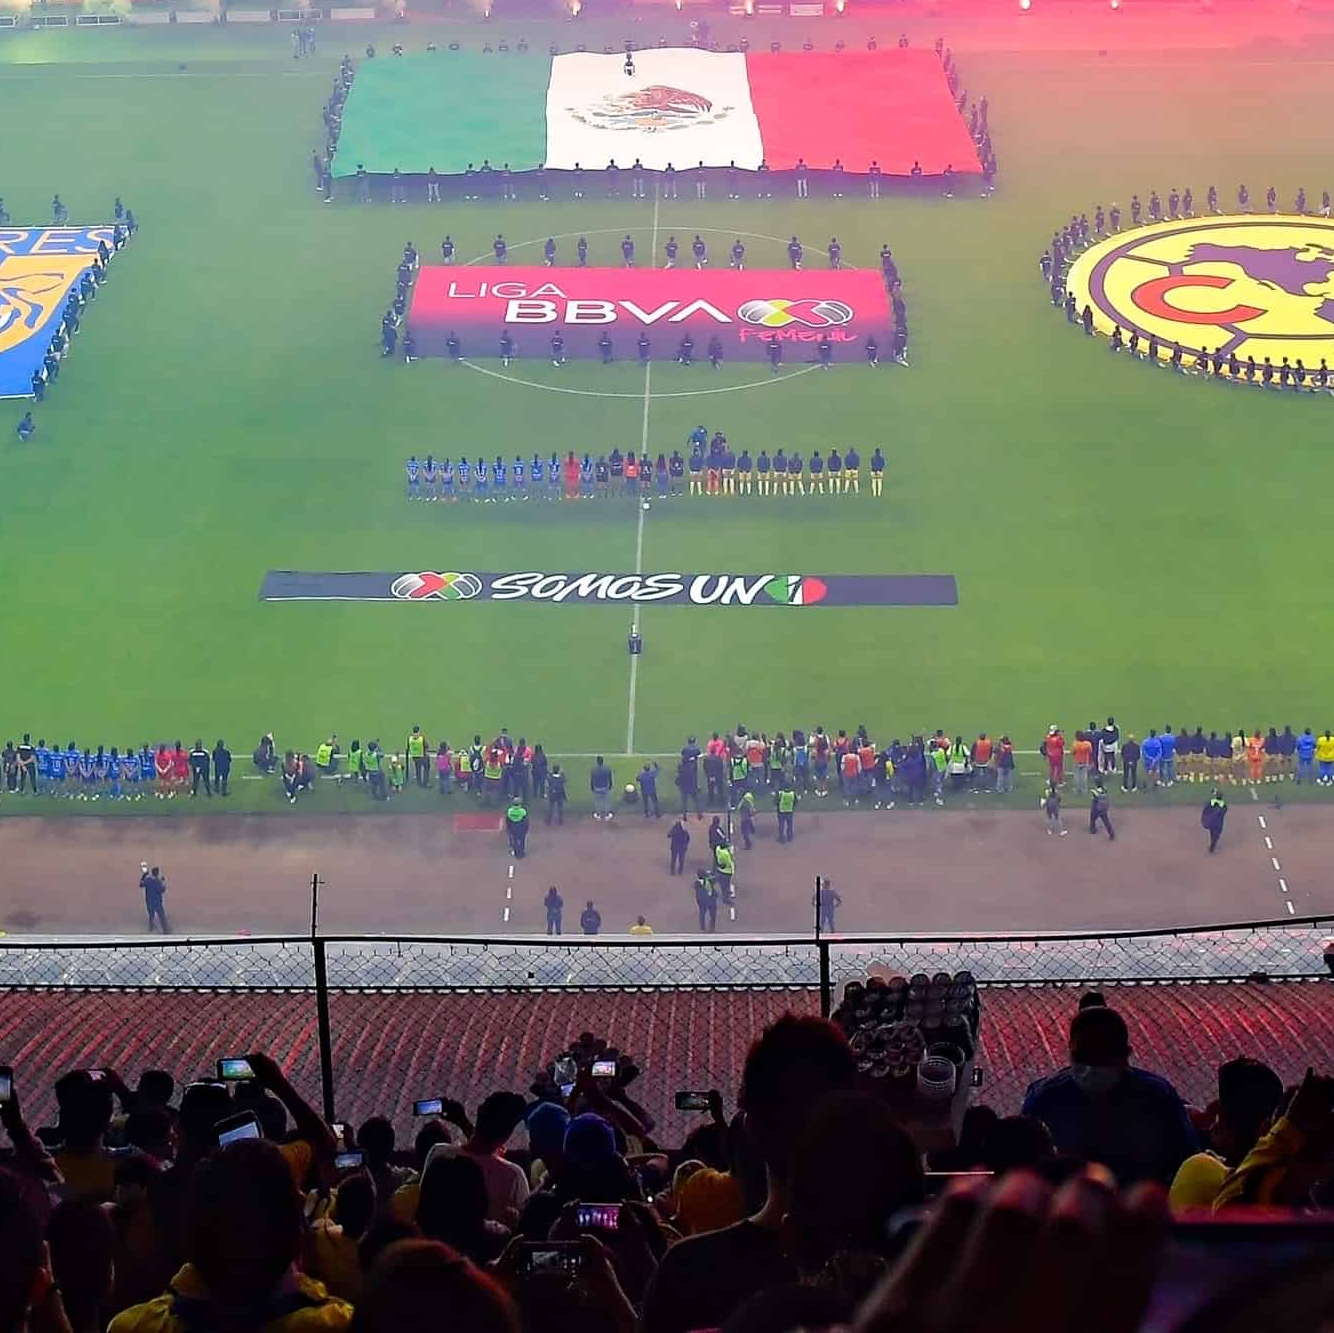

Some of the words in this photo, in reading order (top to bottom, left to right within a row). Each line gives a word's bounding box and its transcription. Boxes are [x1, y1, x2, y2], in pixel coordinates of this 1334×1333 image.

[447, 281, 567, 299] LIGA
[503, 299, 734, 325] BBVA
[489, 572, 684, 603] SOMOS
